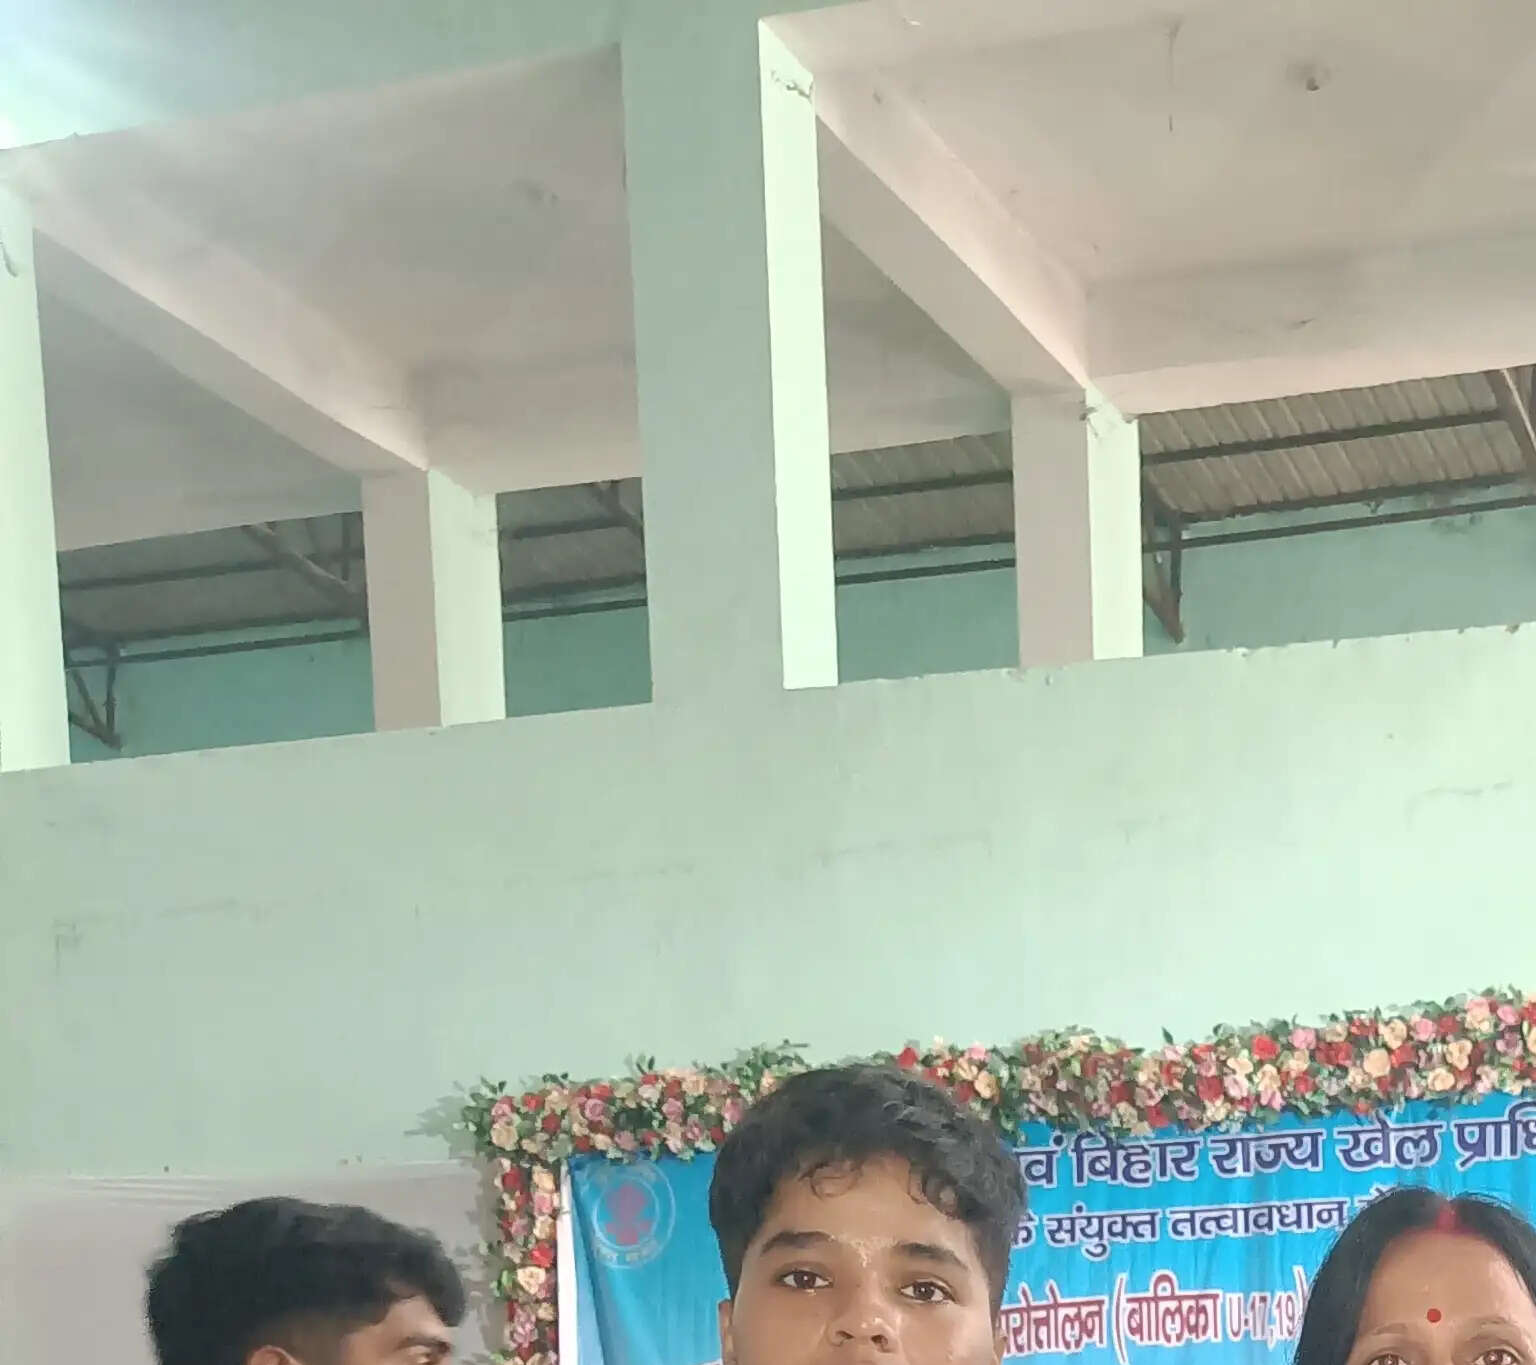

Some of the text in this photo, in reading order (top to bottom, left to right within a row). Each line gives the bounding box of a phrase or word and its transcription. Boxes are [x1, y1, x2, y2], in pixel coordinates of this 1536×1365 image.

[1014, 1133, 1064, 1185] वं
[1072, 1131, 1198, 1185] बिहार
[1212, 1131, 1324, 1175] राज्य
[1338, 1112, 1441, 1168] खेल
[1046, 1204, 1158, 1257] संयुक्त
[1171, 1201, 1347, 1240] तत्वावधान
